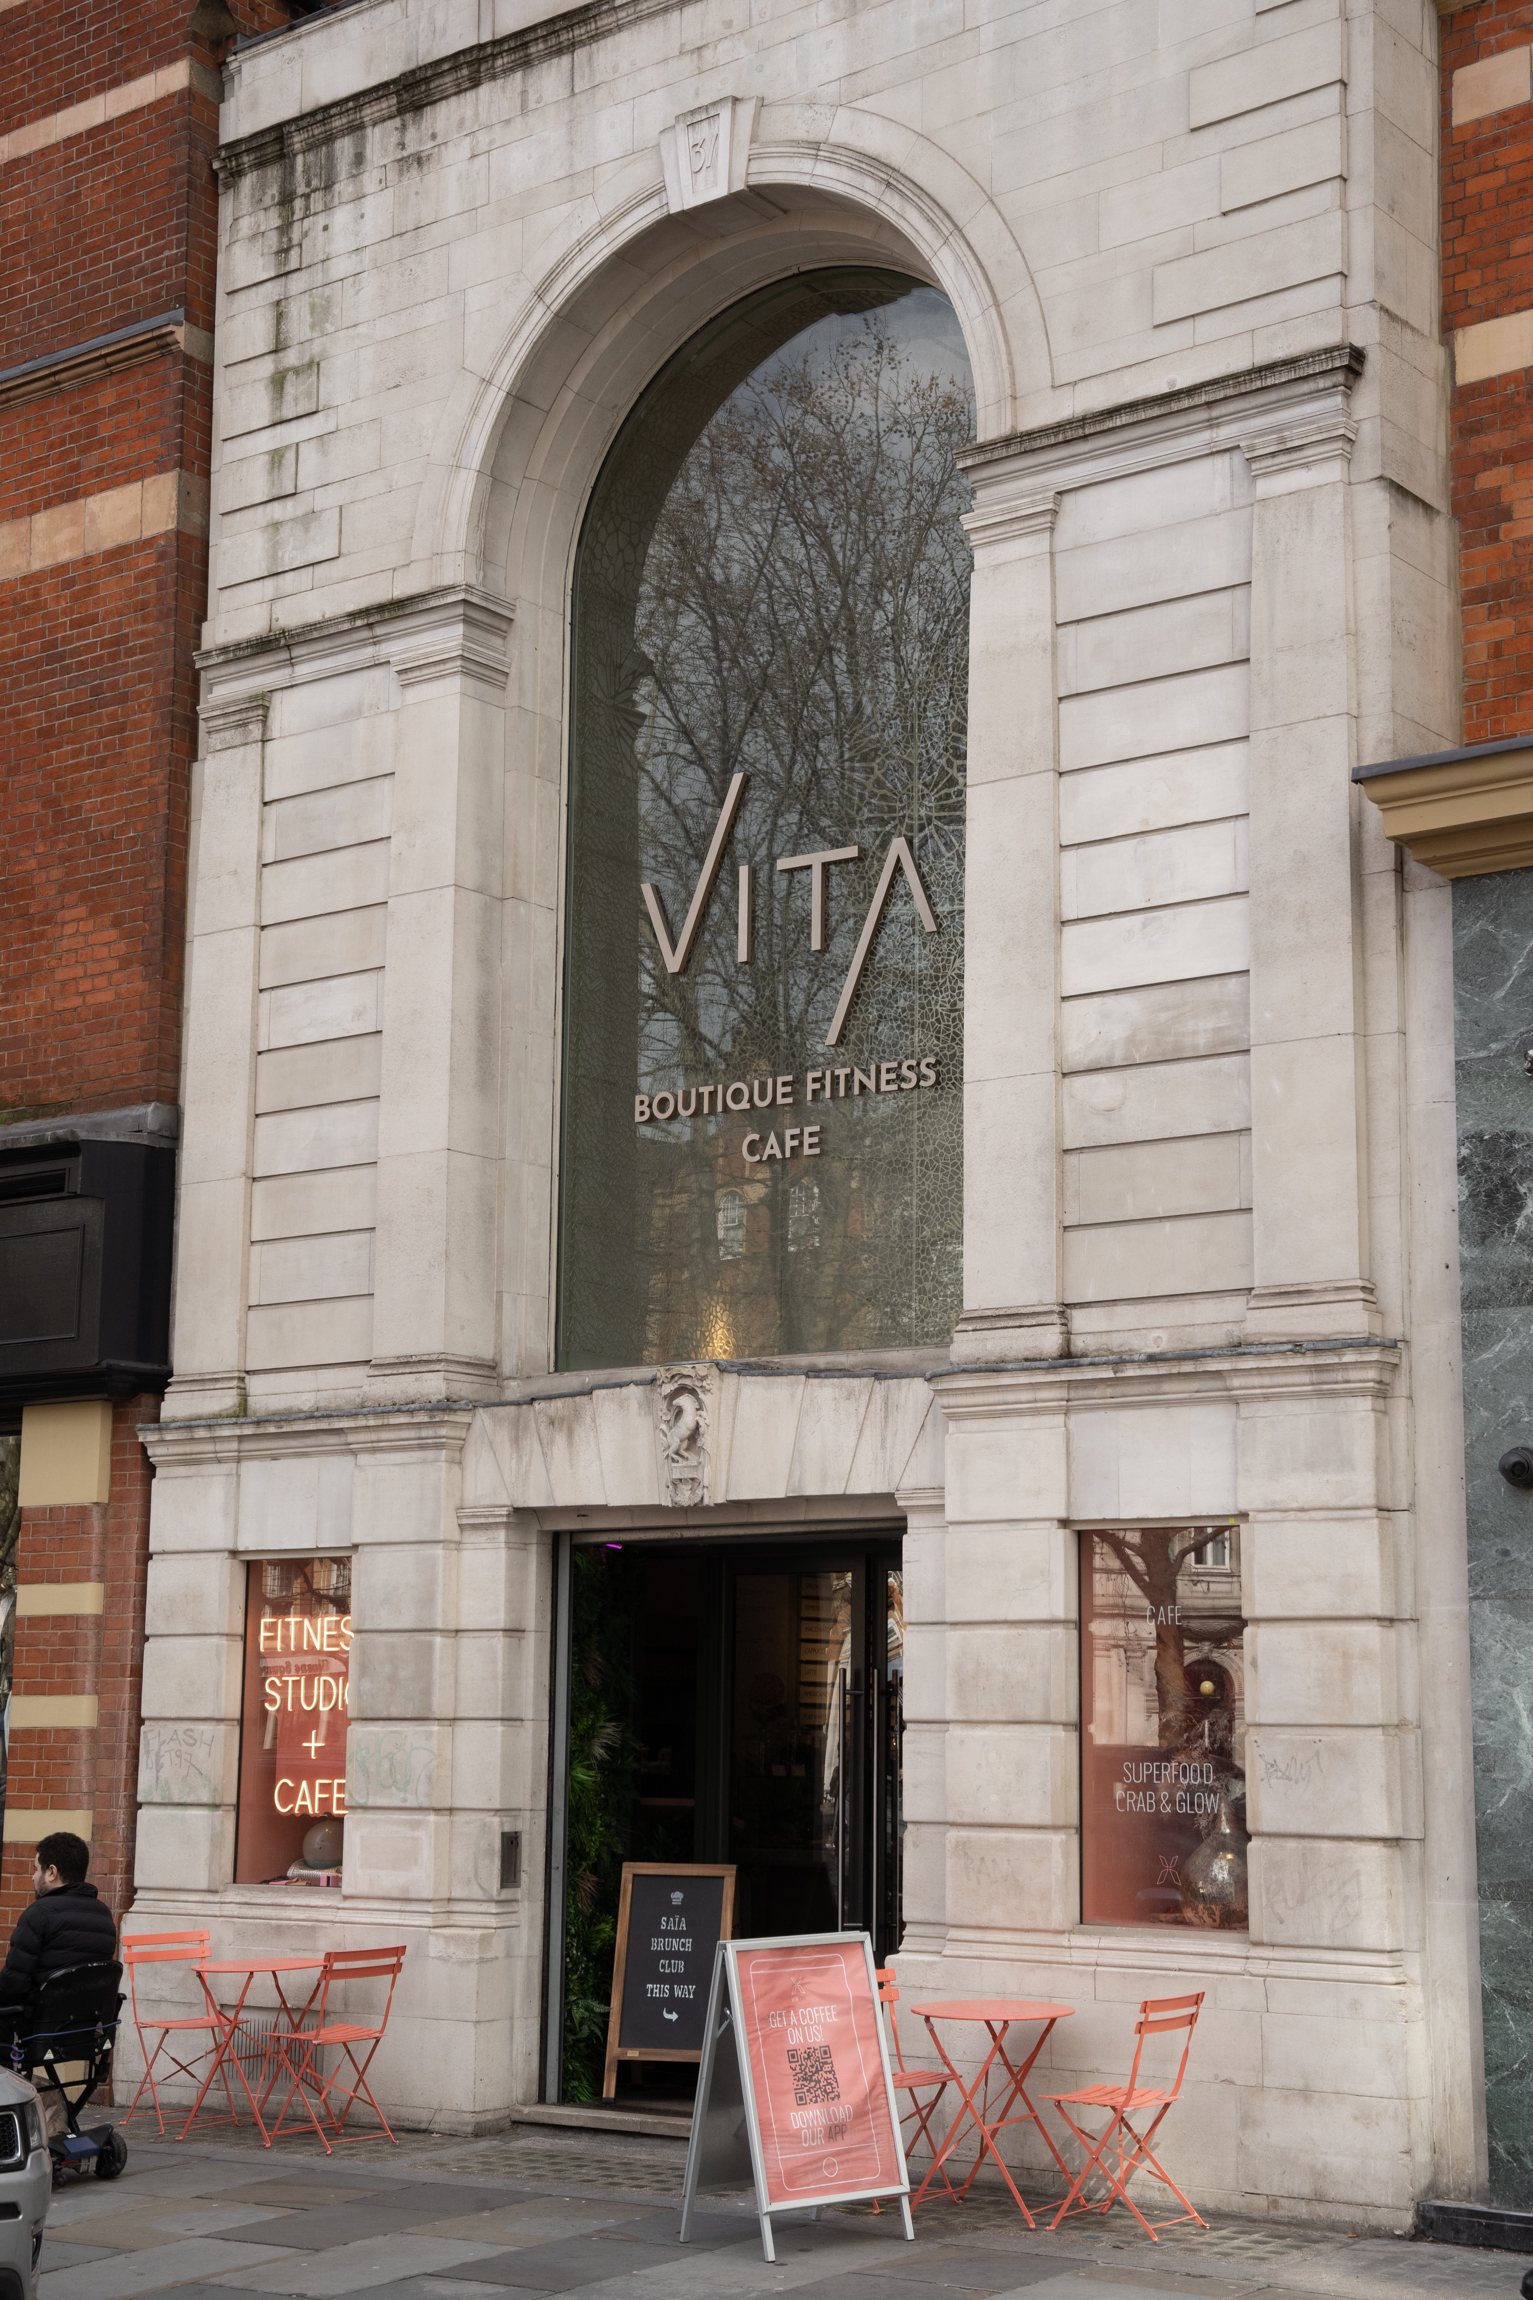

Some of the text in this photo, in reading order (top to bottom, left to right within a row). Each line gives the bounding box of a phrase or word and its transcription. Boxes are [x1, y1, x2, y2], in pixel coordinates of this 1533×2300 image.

[691, 133, 718, 174] 31
[641, 772, 938, 1047] VITA
[634, 1057, 938, 1123] BOUTIQUE FITNESS
[741, 1125, 821, 1163] CAFE
[1146, 1605, 1182, 1626] CAFE
[1122, 1761, 1213, 1784] SUPERFOOD
[274, 1778, 349, 1814] CAFE
[1160, 1791, 1172, 1813] &
[1176, 1792, 1220, 1814] GLOW
[651, 1938, 692, 1952] BRUNCH
[659, 1959, 685, 1973] CLUB
[646, 1984, 696, 1999] THIS WAY
[769, 2005, 838, 2029] GET A COFFEE
[787, 2025, 824, 2045] ON US!
[790, 2105, 853, 2129] DOWNLOAD
[801, 2124, 848, 2147] OUR APP
